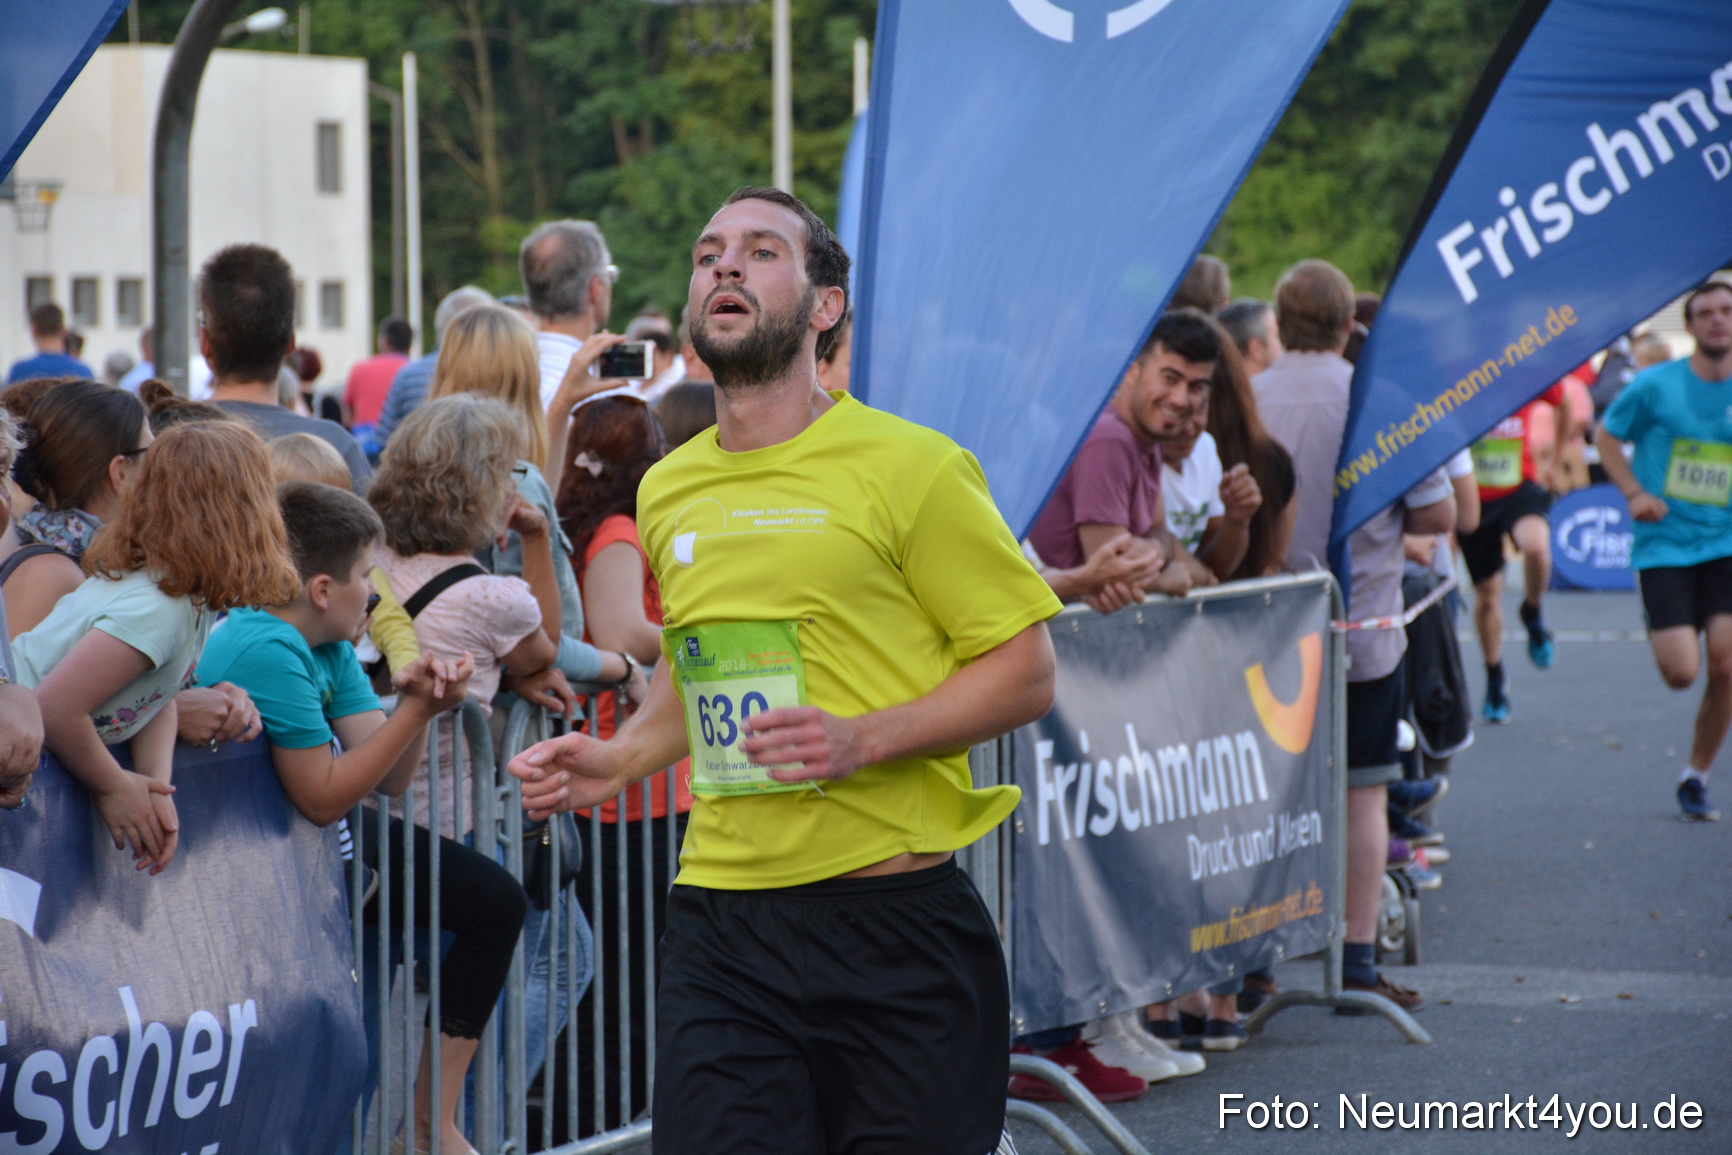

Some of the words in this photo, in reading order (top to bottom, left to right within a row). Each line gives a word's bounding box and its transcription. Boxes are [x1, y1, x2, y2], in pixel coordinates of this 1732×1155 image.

[731, 508, 765, 518] Kliniken
[753, 517, 794, 526] Neumarkt
[698, 691, 770, 748] 630
[1035, 723, 1269, 845] Frischmann
[1187, 823, 1239, 881] Druck
[1238, 813, 1276, 868] und
